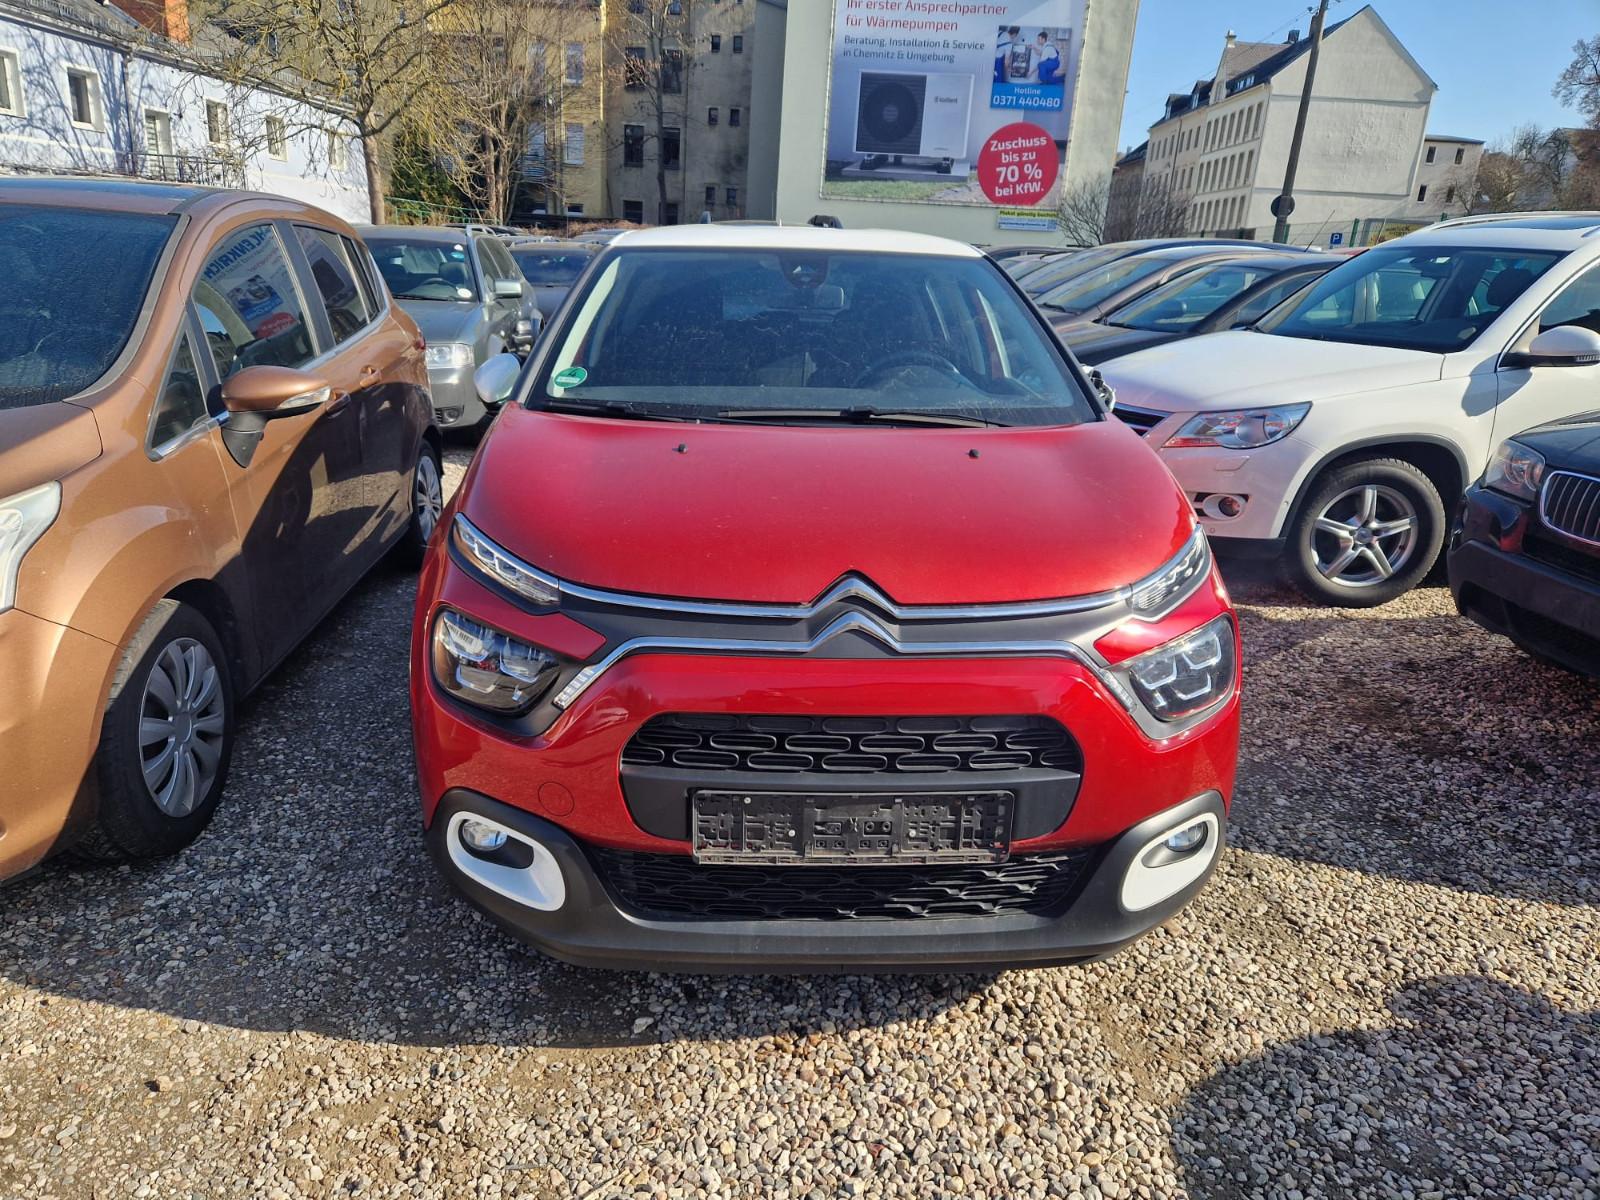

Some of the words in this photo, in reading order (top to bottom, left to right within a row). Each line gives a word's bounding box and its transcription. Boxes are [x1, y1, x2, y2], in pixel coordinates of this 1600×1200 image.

[847, 0, 862, 9] Ihr
[866, 0, 901, 10] erster
[905, 0, 1008, 16] Ansprechpartner
[846, 14, 863, 26] für
[866, 16, 958, 32] Wärmepumpen
[844, 35, 887, 48] Beratung,
[889, 37, 941, 48] Installation
[943, 39, 950, 49] &
[952, 40, 985, 50] Service
[843, 48, 852, 57] in
[853, 48, 896, 59] Chemnitz
[896, 50, 904, 59] &
[906, 51, 955, 63] Umgebung
[1014, 87, 1042, 95] Hotline
[993, 95, 1016, 105] 0371
[1018, 96, 1060, 108] 440480
[990, 136, 1047, 151] Zuschuss
[1001, 151, 1020, 163] bis
[1022, 151, 1036, 161] zu
[996, 165, 1019, 183] 70
[1023, 162, 1042, 181] %
[995, 184, 1013, 197] bei
[1015, 181, 1044, 195] KfW.
[1333, 233, 1340, 242] P
